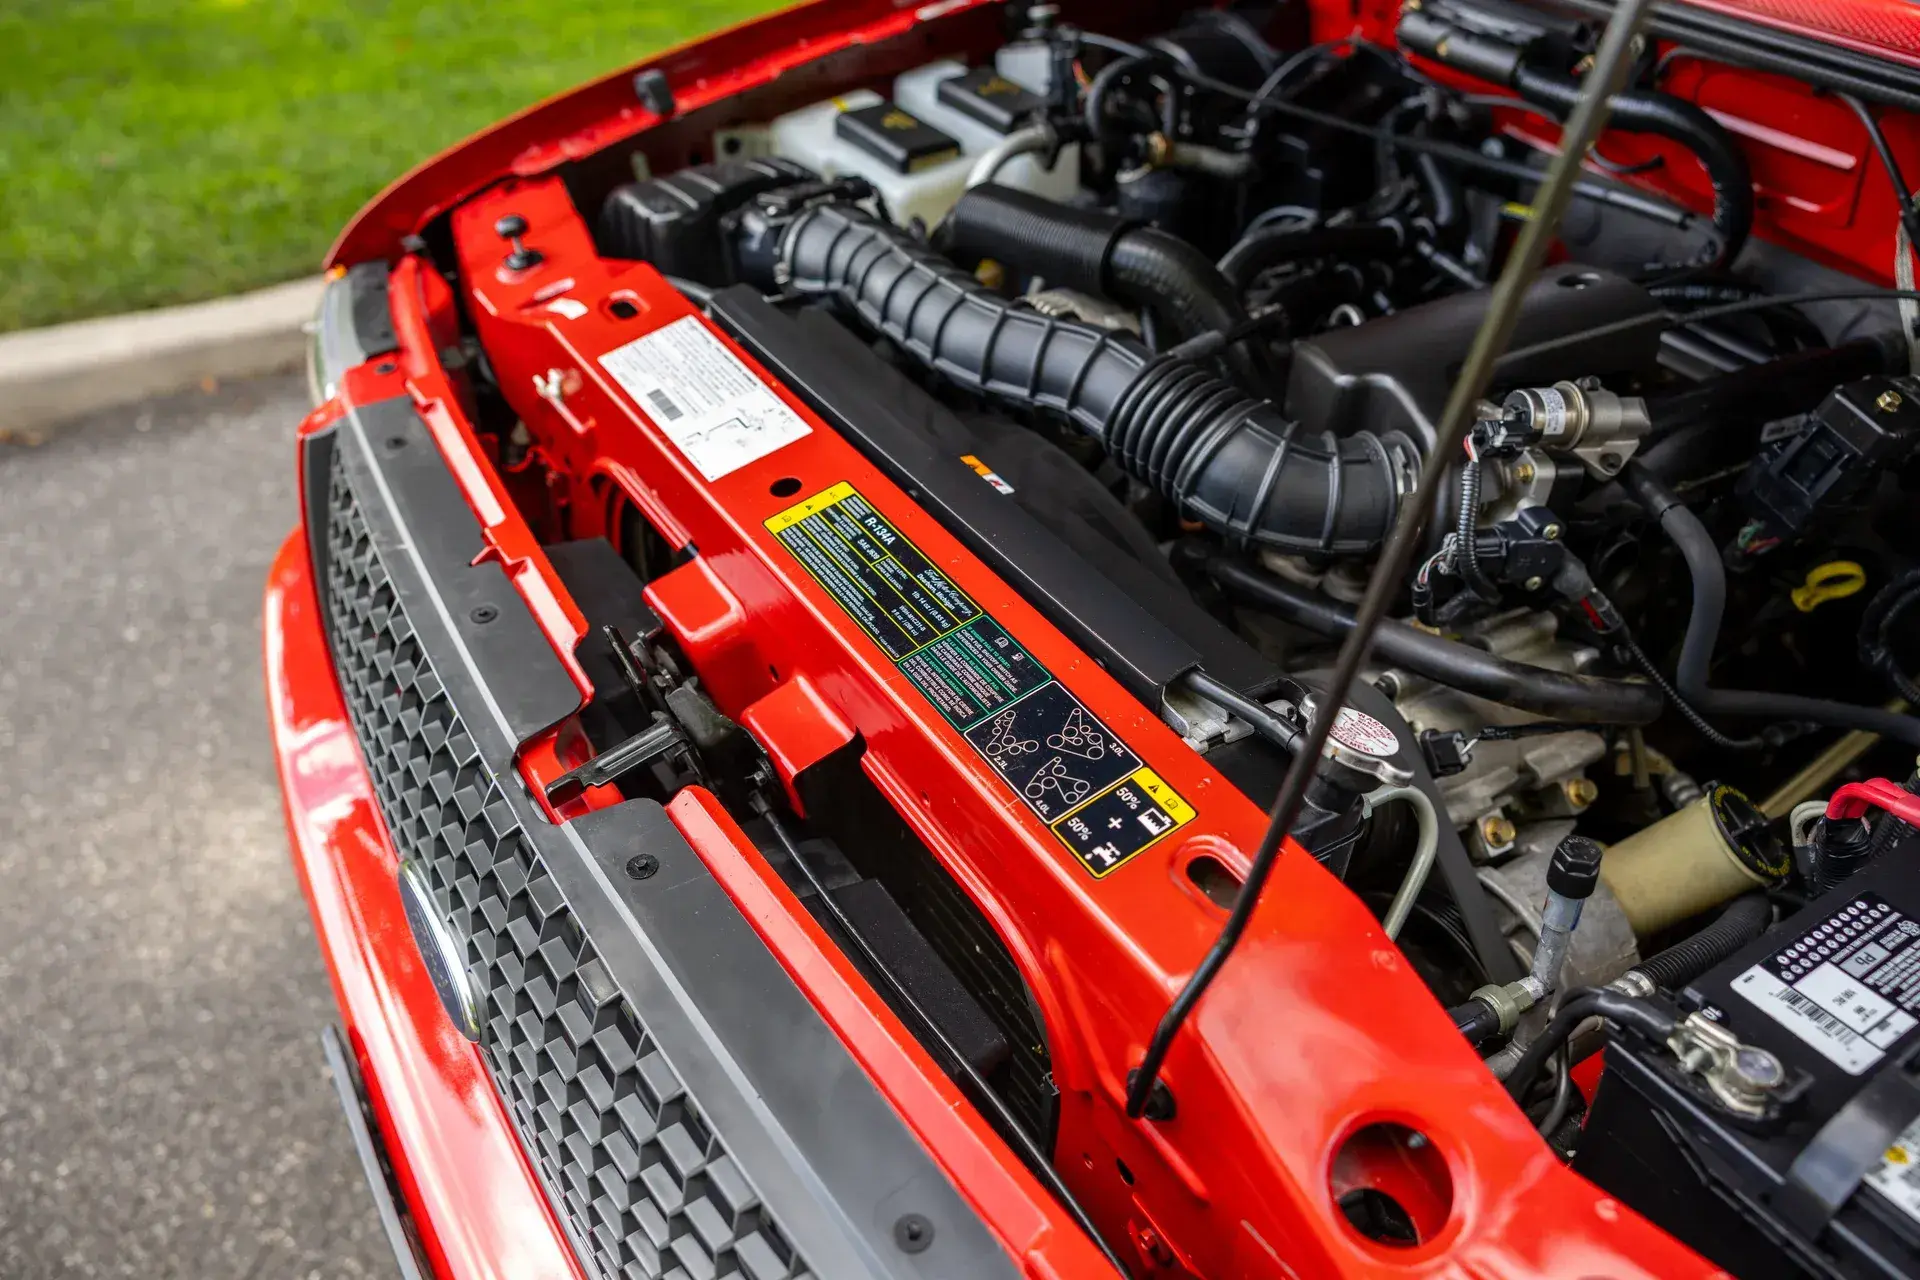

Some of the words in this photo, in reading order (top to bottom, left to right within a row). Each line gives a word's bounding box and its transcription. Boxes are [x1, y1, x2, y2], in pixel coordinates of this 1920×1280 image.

[864, 517, 896, 545] R-134A
[857, 539, 870, 550] SAE
[866, 549, 880, 559] J639
[917, 573, 936, 593] Dearborn,
[935, 591, 955, 610] Michigan
[930, 646, 942, 657] DANS
[944, 660, 957, 672] GUIDE
[955, 632, 979, 655] REFERENCED
[981, 657, 993, 668] YOUR
[991, 667, 1006, 681] OWNER
[1003, 680, 1017, 693] GUIDE.
[961, 629, 975, 641] CHECK
[972, 640, 983, 650] FUEL
[981, 649, 999, 664] SHUTOFF
[996, 664, 1013, 678] SWITCH
[908, 658, 917, 667] DEL
[915, 665, 941, 690] COMBUSTIBLE
[938, 689, 951, 701] COMO
[953, 704, 967, 718] INDICA
[914, 655, 929, 668] REVISE
[930, 672, 956, 696] INTERRUPTOR
[957, 701, 974, 715] CIERRE
[960, 660, 982, 680] COMMANDE
[985, 684, 1004, 703] COUPURE
[993, 755, 1008, 770] 2.3L
[1109, 742, 1124, 757] 3.0L
[1035, 800, 1050, 814] 4.0L
[1116, 787, 1141, 809] 50%
[1067, 817, 1092, 840] 50%
[1854, 951, 1877, 965] Pb
